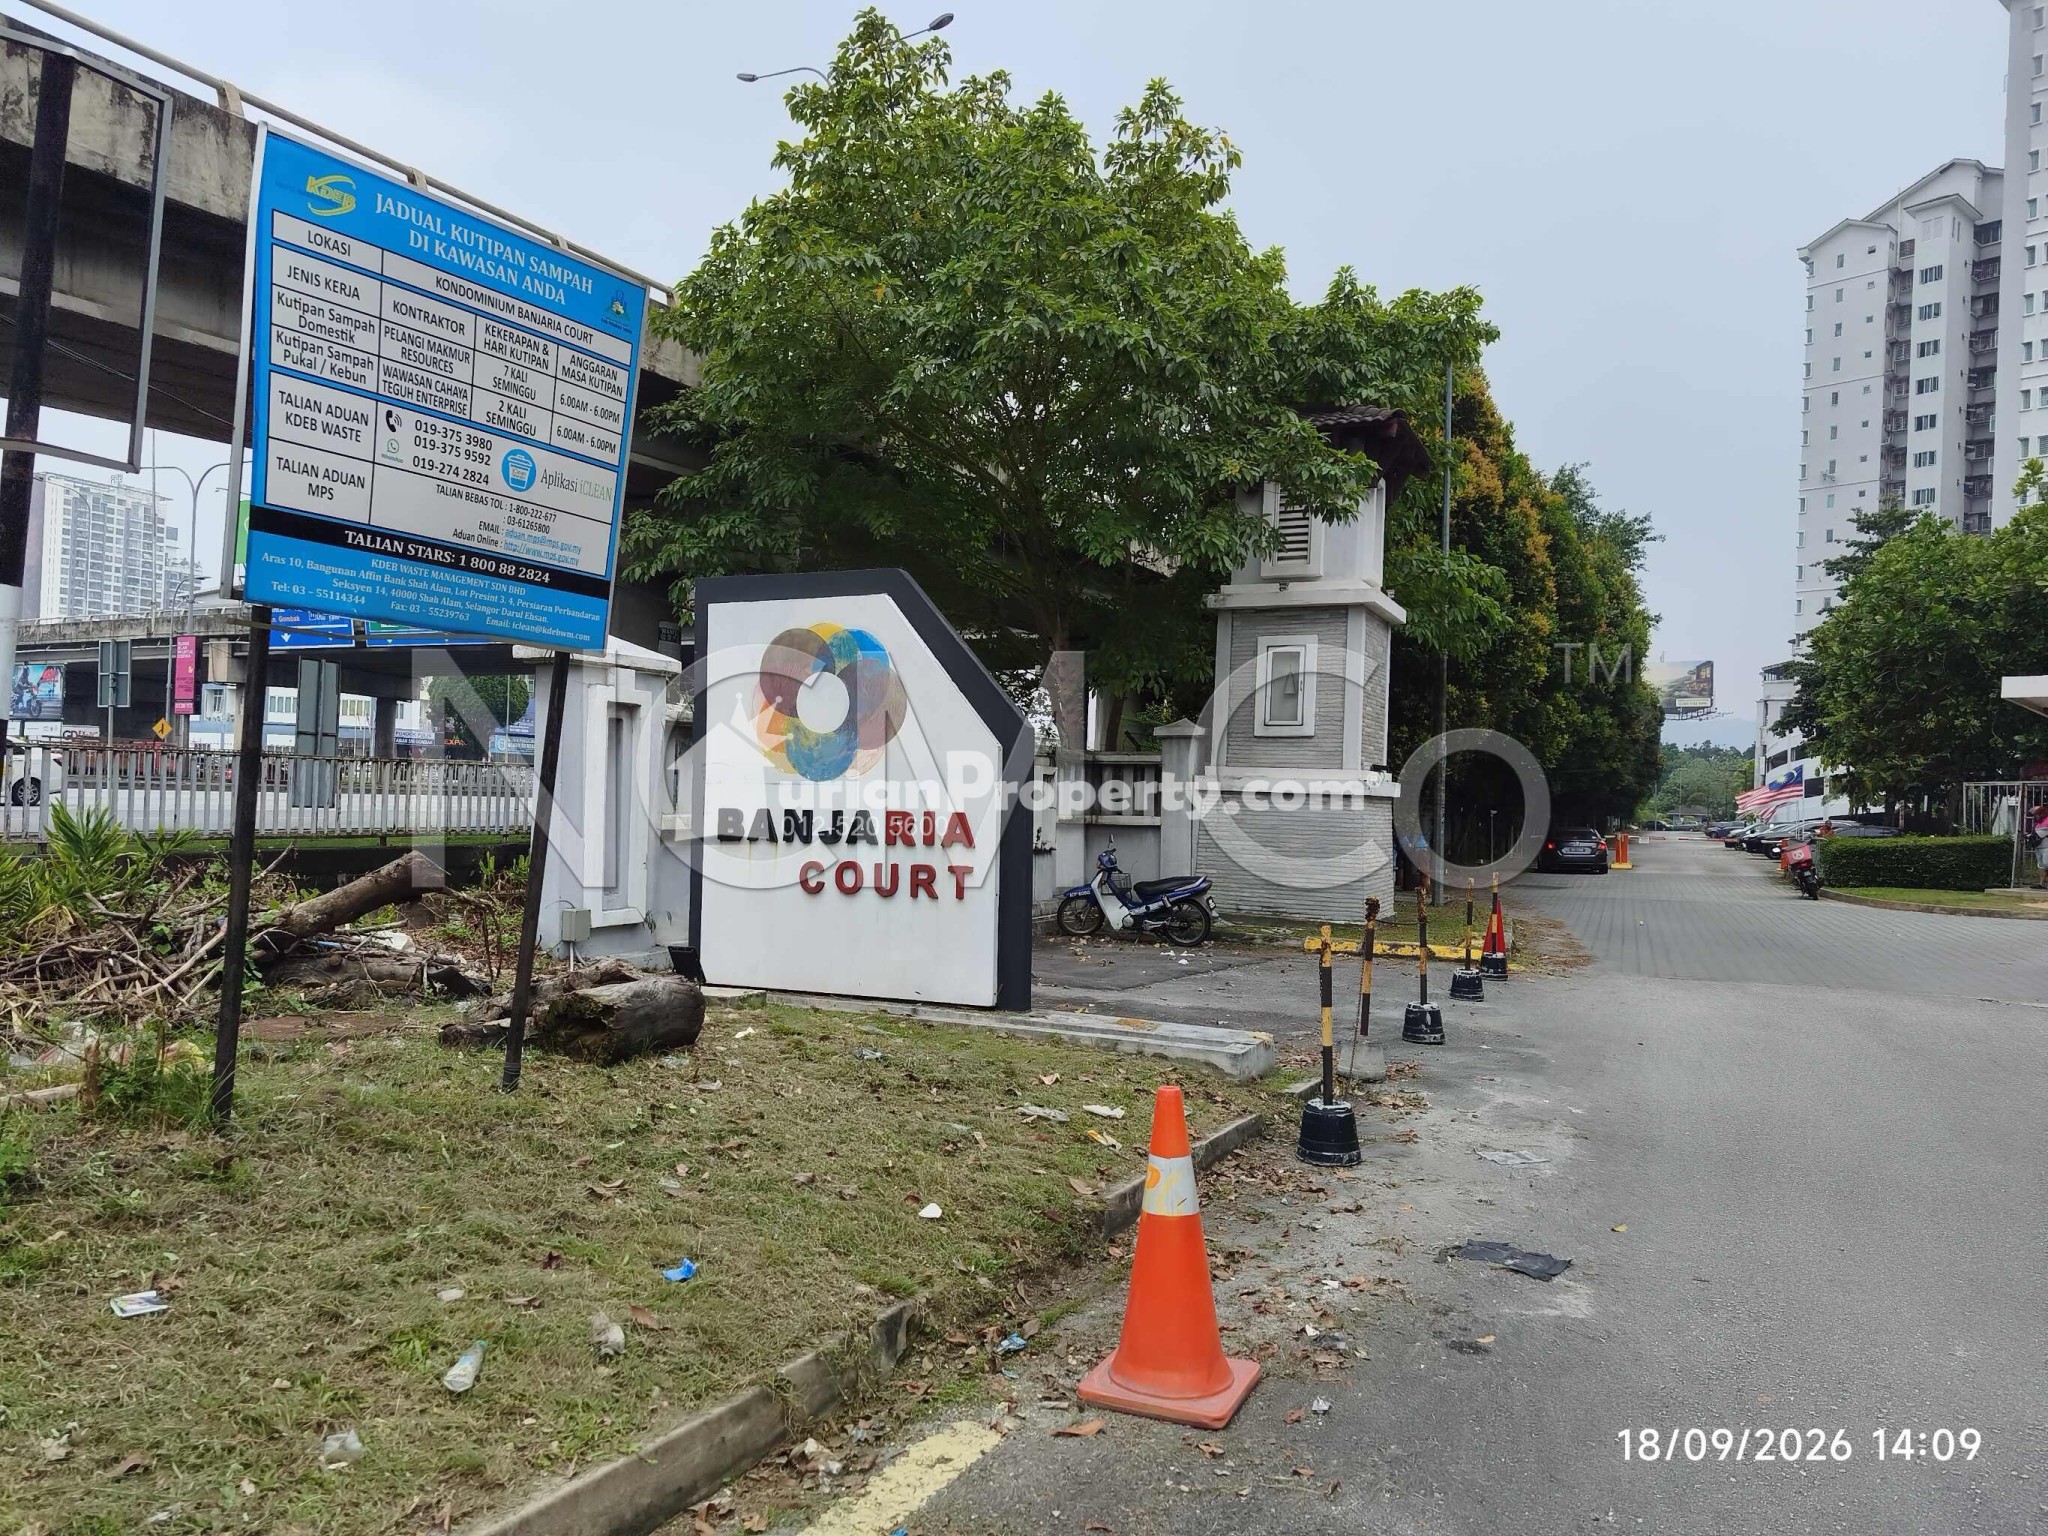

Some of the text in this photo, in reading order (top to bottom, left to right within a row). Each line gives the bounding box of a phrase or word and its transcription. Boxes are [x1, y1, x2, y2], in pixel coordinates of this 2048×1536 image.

[306, 176, 356, 208] KDEB
[308, 230, 351, 256] LOKASI
[375, 193, 592, 294] JADUAL KUTIPAN SAMPAH
[287, 265, 360, 300] JENIS KERJA
[409, 229, 566, 305] DI KAWASAN ANDA
[277, 291, 375, 334] Kutipan Sampah
[393, 300, 465, 336] KONTRAKTOR
[436, 276, 515, 315] KONDOMINIUM
[517, 306, 562, 333] BANJARIA
[564, 324, 593, 345] COURT
[299, 315, 355, 344] Domestik
[384, 325, 470, 364] PELANGI MAKMUR
[485, 323, 549, 356] KEKERAPAN &
[276, 330, 374, 371] Kutipan Sampah
[283, 349, 366, 384] Pukal / Kebun
[401, 346, 454, 374] RESOURCES
[484, 338, 549, 370] HARI KUTIPAN
[382, 363, 468, 401] WAWASAN CAHAYA
[504, 365, 528, 383] 7 KALI
[561, 365, 623, 397] MASA KUTIPAN
[570, 354, 617, 381] ANGGARAN
[382, 379, 467, 416] TEGUH ENTERPRISE
[492, 376, 536, 400] SEMINGGU
[279, 390, 369, 427] TALIAN ADUAN
[485, 411, 537, 436] SEMINGGU
[498, 400, 527, 419] 2 KALI
[560, 393, 588, 413] 6.00AM
[593, 406, 620, 424] 6.00PM
[285, 411, 362, 443] KDEB WASTE
[414, 419, 492, 451] 019-375 3980
[556, 425, 585, 445] 6.00AM
[590, 436, 617, 455] 6.00PM
[414, 435, 491, 466] 019-375 9592
[276, 456, 365, 489] TALIAN ADUAN
[412, 455, 490, 486] 019-274 2824
[540, 468, 613, 502] Aplikasi iCLEAN
[307, 483, 334, 500] MPS
[436, 484, 464, 501] TALIAN
[465, 491, 489, 506] BEBAS
[490, 497, 504, 511] TOL
[509, 503, 557, 523] 1-800-222-677
[452, 528, 476, 542] Aduan
[476, 533, 499, 548] Online
[478, 520, 500, 534] EMAIL
[507, 515, 551, 534] 03-61265800
[345, 530, 551, 583] TALIAN STARS: 1 800 88 2824
[262, 552, 286, 565] Aras
[288, 557, 304, 569] 10,
[306, 559, 357, 577] Bangunan
[358, 569, 382, 582] Affin
[384, 573, 406, 586] Bank
[407, 578, 429, 590] Shah
[430, 583, 454, 595] Alam,
[455, 587, 468, 596] Lot
[470, 590, 498, 603] Presint
[516, 598, 553, 613] Persiaran
[554, 605, 600, 621] Perbandaran
[371, 558, 526, 595] KDEB WASTE MANAGEMENT SDN BHD
[271, 581, 290, 593] Tel:
[292, 584, 306, 595] 03
[315, 588, 366, 605] 55114344
[332, 577, 549, 623] Seksyen 14, 40000 Shah Alam, Selangor Darul Ehsan.
[391, 600, 408, 612] Fax:
[409, 603, 421, 614] 03
[428, 607, 470, 621] 55239763
[486, 616, 591, 642] Email: iclean@kdebwm.com
[717, 808, 975, 849] BANJARIA
[799, 860, 974, 900] COURT
